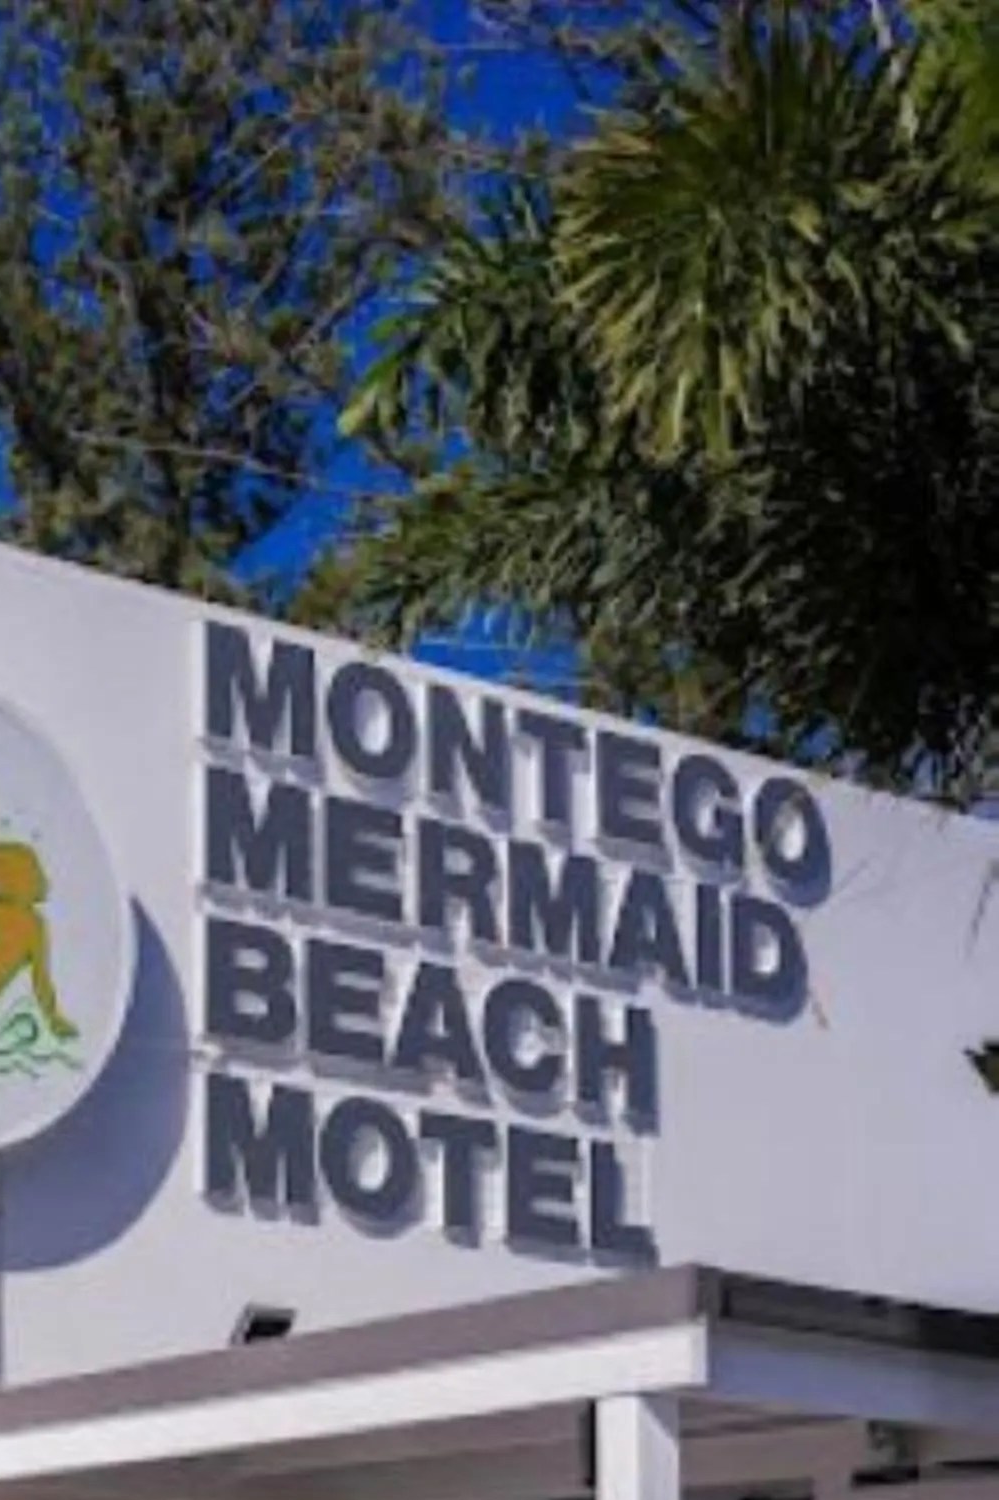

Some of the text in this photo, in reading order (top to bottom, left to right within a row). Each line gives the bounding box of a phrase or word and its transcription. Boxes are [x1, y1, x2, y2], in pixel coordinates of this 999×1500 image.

[204, 619, 831, 906] MONTEGO
[204, 767, 809, 1006] MERMAID
[204, 918, 656, 1116] BEACH
[204, 1073, 655, 1255] MOTEL
